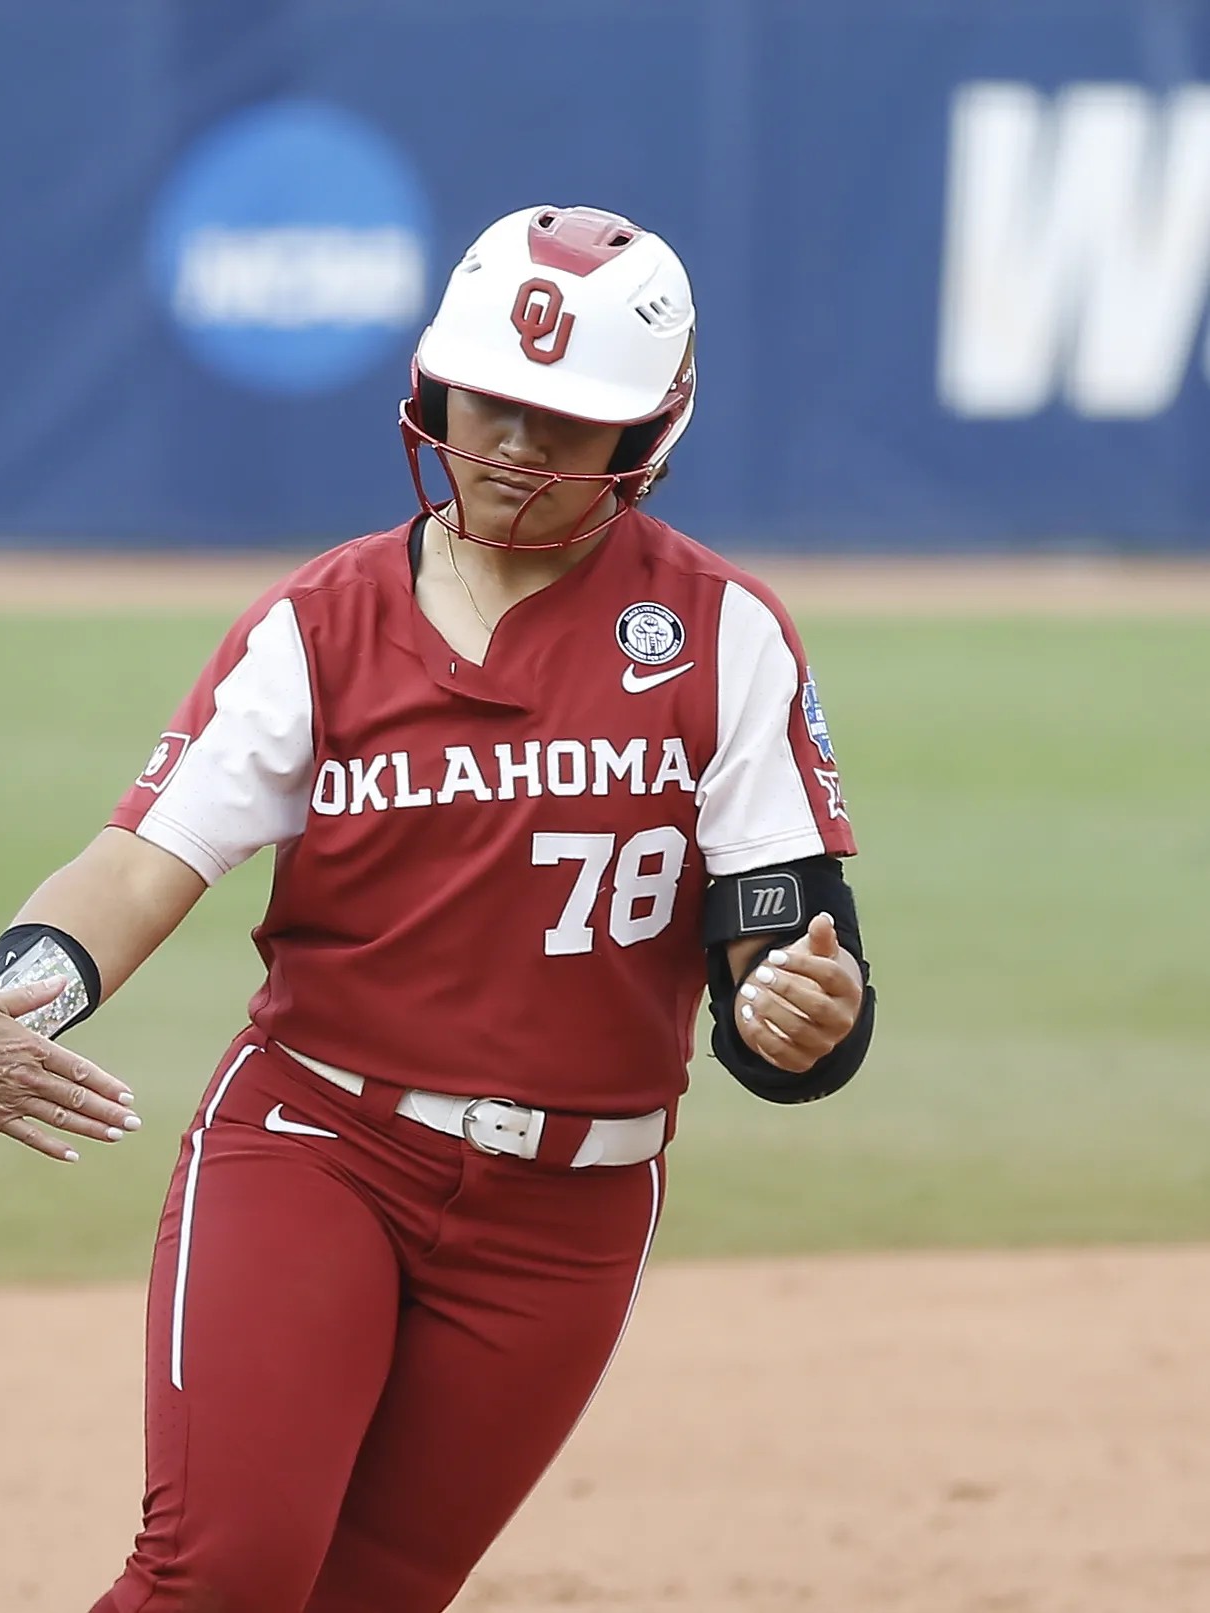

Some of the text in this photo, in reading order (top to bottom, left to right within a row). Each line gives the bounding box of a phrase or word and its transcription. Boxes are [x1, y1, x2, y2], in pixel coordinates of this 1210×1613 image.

[510, 277, 576, 365] OU
[310, 737, 697, 816] OKLAHOMA
[531, 826, 688, 956] 78
